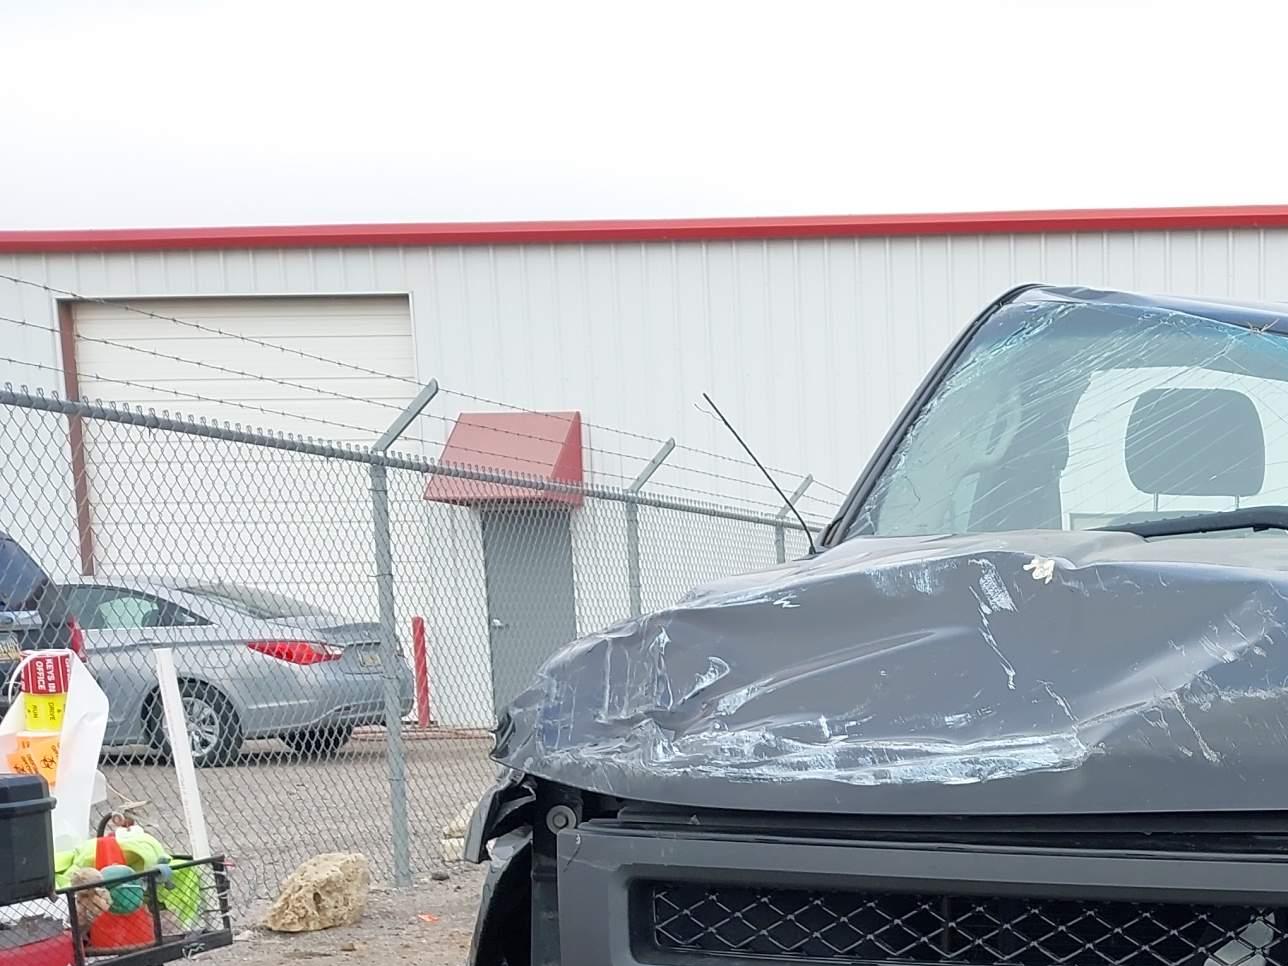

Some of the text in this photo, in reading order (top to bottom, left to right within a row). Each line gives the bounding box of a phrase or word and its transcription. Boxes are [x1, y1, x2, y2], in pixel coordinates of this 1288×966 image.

[35, 660, 47, 691] OFFICE
[45, 656, 57, 692] KEYS IN
[47, 701, 57, 721] DRIVE
